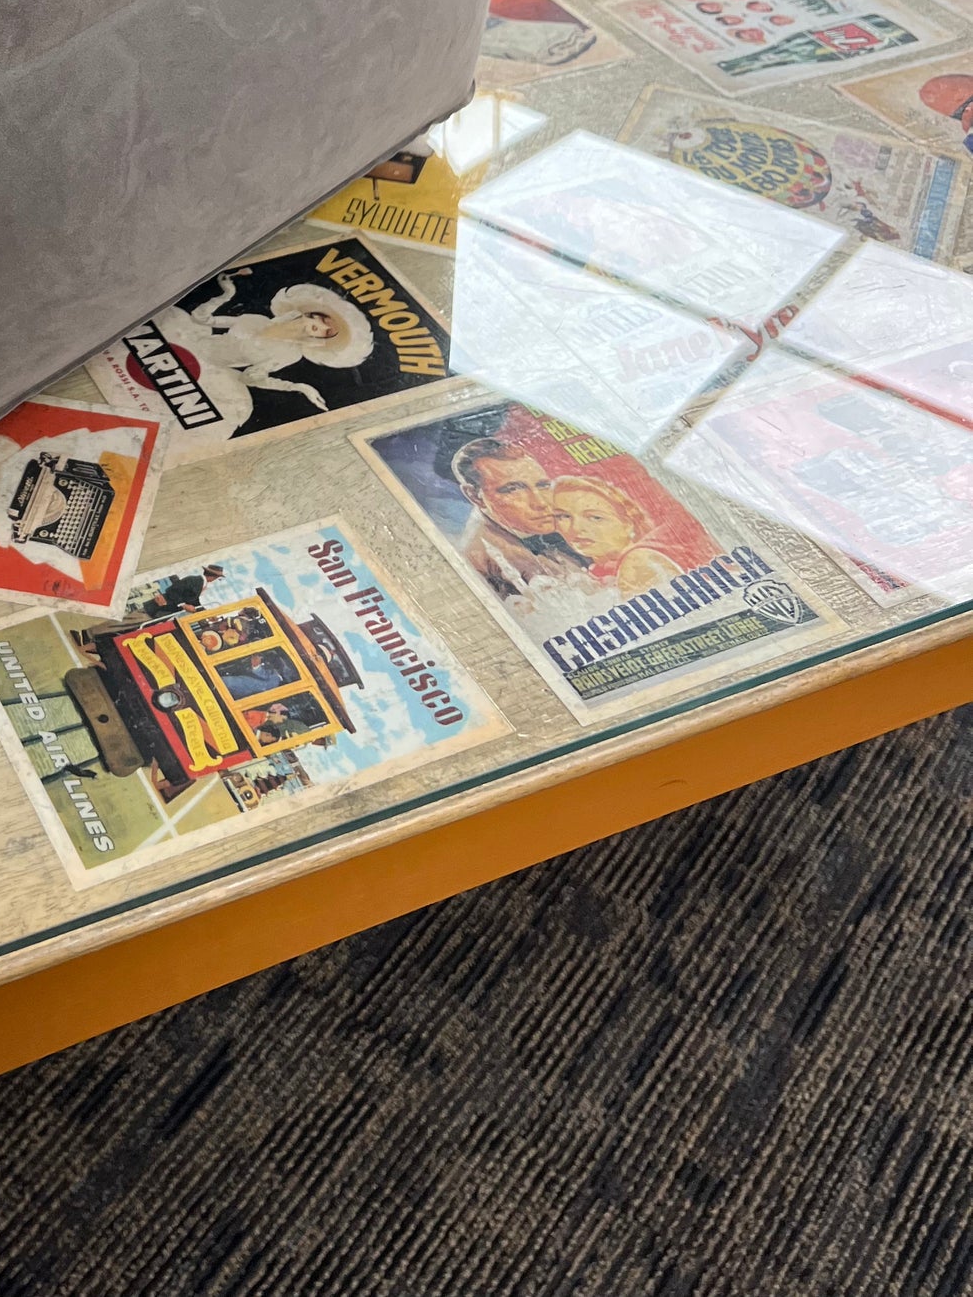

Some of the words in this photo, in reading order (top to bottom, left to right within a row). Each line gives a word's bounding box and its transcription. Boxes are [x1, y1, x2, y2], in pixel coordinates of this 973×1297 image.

[342, 198, 455, 244] SYLOUETTE
[750, 169, 789, 191] 80
[315, 248, 446, 377] VERMOUTH
[112, 364, 130, 386] ROSSI
[308, 538, 356, 588] San
[343, 584, 464, 728] Francisco
[542, 546, 774, 674] CASABLANCA
[38, 730, 71, 769] AIR
[63, 779, 115, 852] LINES
